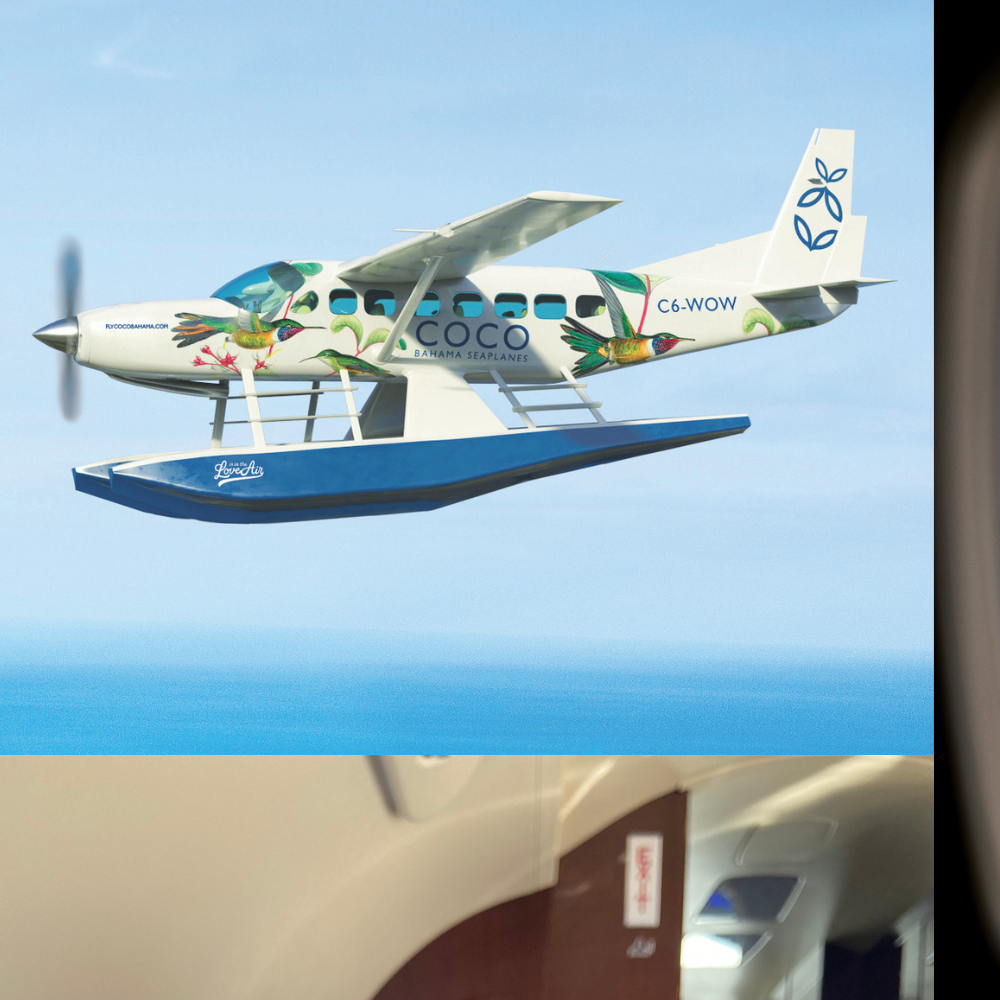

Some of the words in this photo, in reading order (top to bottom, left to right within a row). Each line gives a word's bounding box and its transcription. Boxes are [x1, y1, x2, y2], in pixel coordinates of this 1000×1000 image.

[657, 296, 737, 314] C6-WOW
[415, 320, 530, 351] COCO
[414, 349, 462, 359] BAHAMA
[467, 351, 529, 363] SEAPLANES
[214, 460, 240, 480] Love
[240, 460, 264, 476] Air
